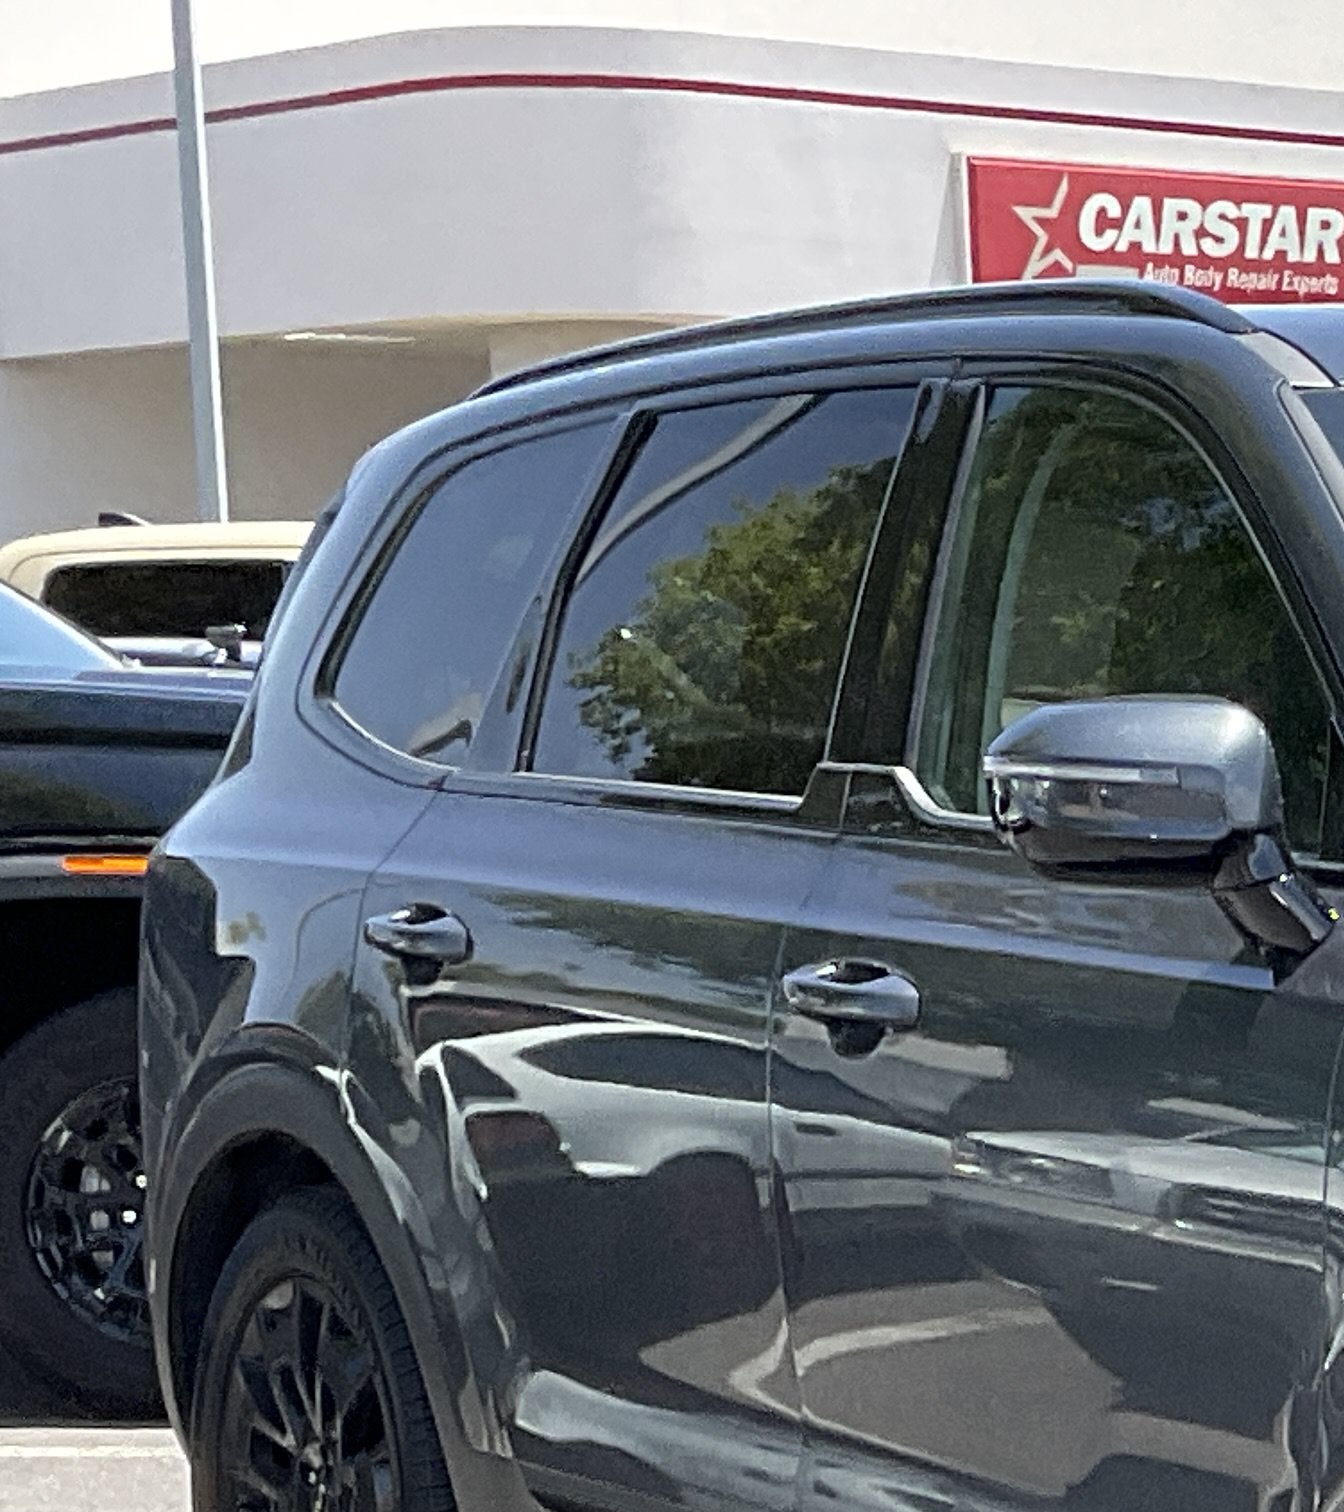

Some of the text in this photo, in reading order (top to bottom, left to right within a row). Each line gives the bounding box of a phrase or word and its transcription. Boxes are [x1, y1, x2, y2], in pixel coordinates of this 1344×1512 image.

[1143, 262, 1340, 300] Auto Body Repair Experts
